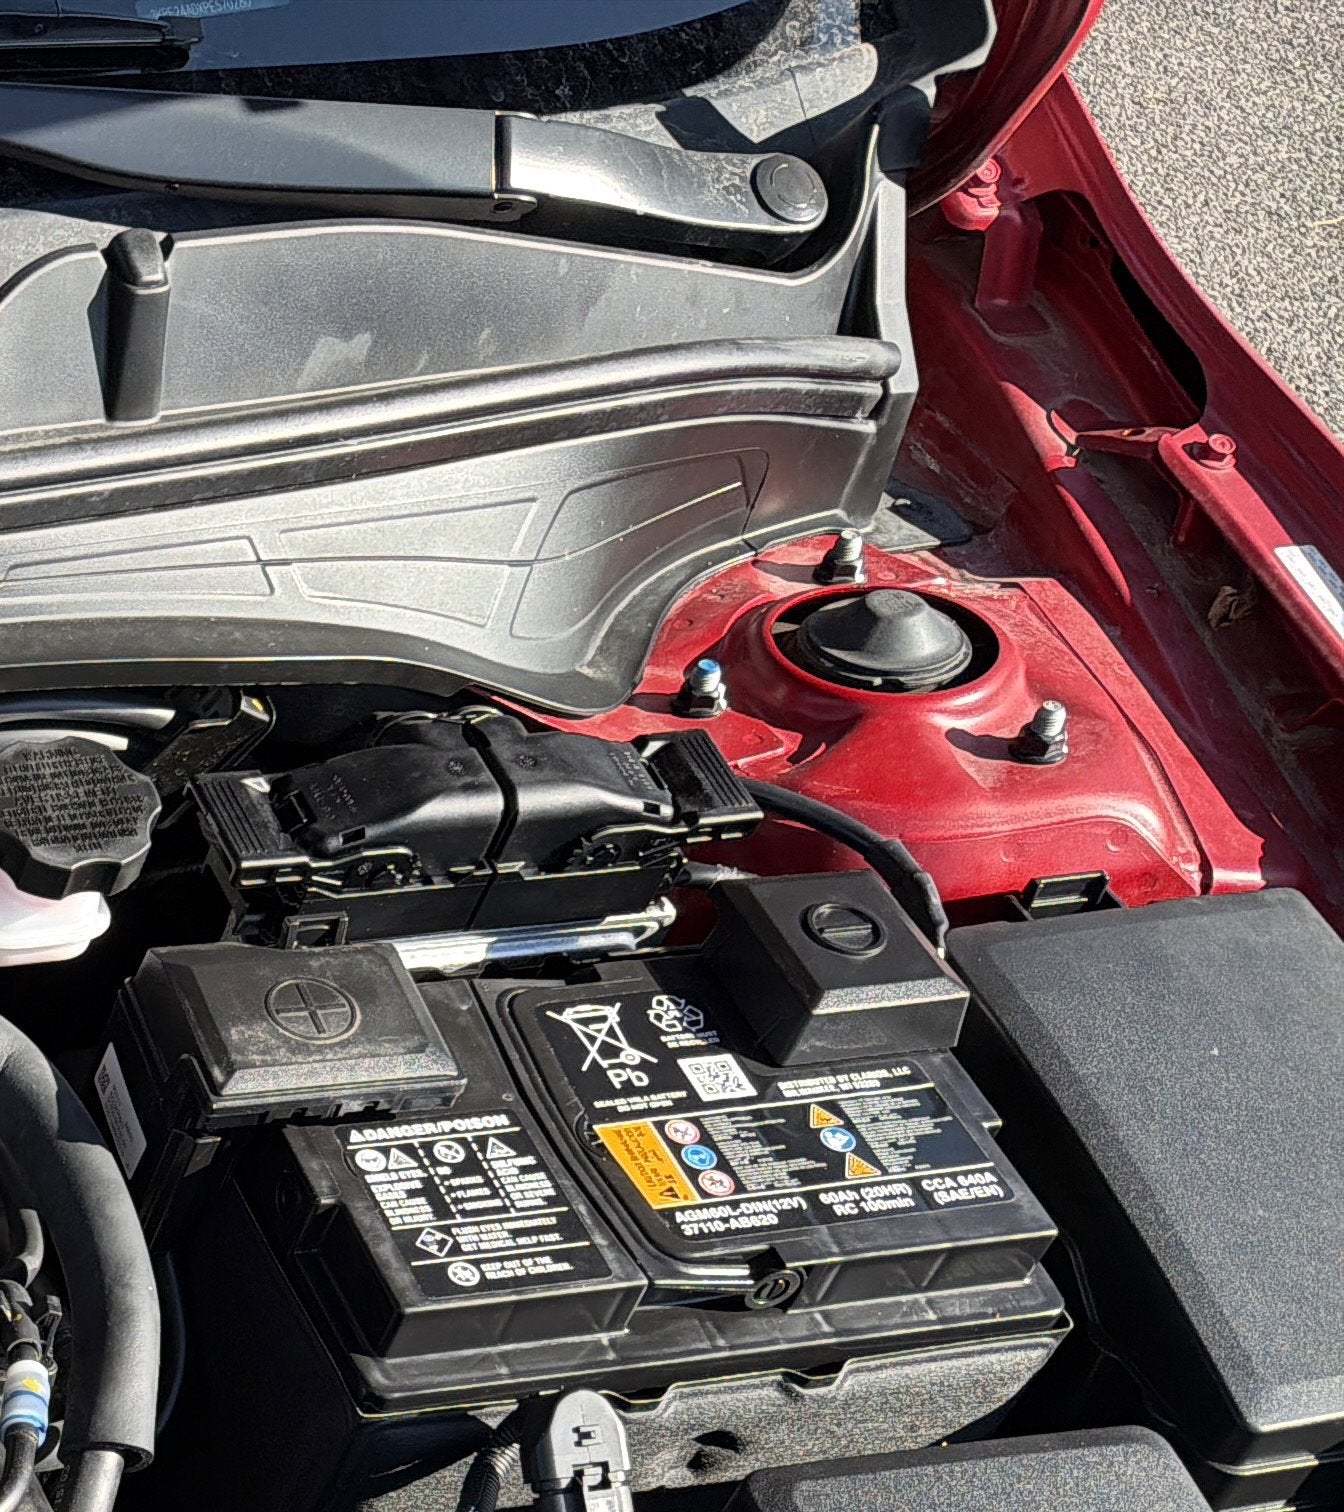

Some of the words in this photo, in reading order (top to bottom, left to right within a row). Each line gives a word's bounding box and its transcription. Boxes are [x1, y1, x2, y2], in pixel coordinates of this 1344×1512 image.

[607, 1069, 649, 1089] Pb
[363, 1114, 510, 1141] DANGER/POISON
[921, 1177, 958, 1191] CCA
[961, 1172, 998, 1186] 640A
[819, 1188, 859, 1205] 60Ah
[861, 1183, 912, 1199] (20HR)
[934, 1185, 1004, 1205] (SAE/EN)
[833, 1202, 859, 1216] RC
[861, 1196, 916, 1214] 100min
